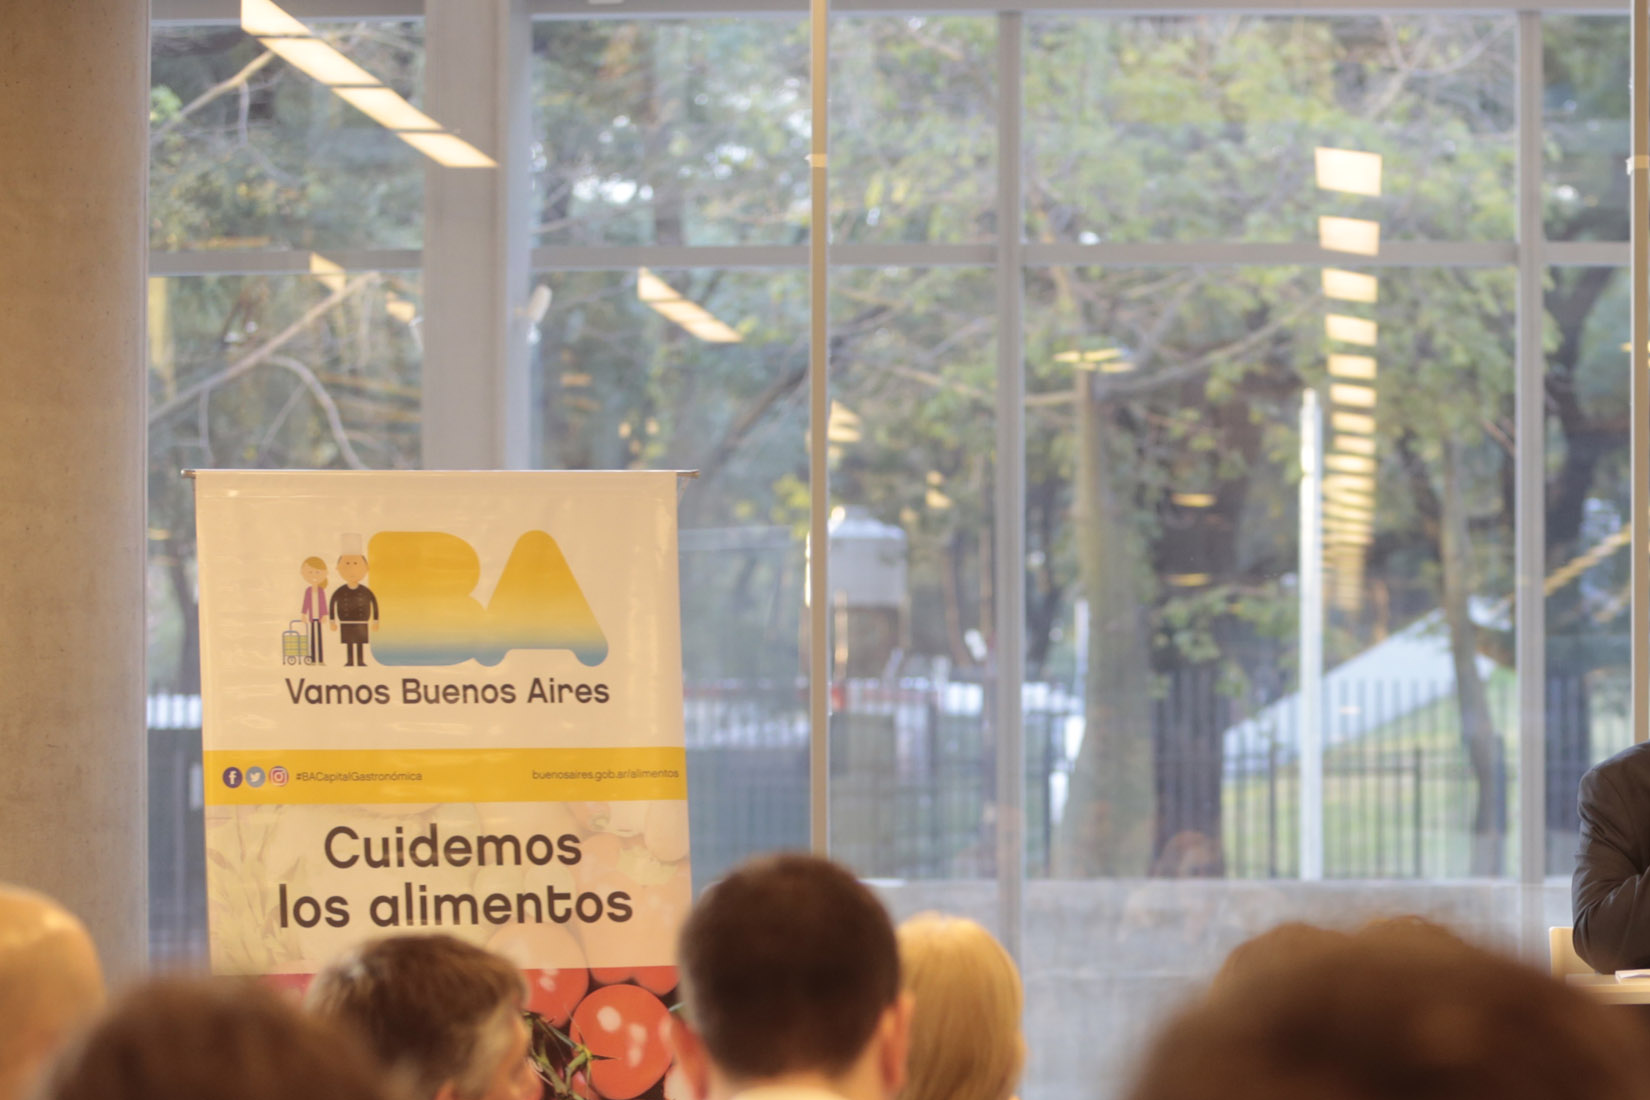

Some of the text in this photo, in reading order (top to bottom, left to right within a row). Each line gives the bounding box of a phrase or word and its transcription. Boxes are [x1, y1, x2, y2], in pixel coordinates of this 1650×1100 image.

[367, 529, 610, 667] BA
[284, 676, 611, 705] Vamos Buenos Aires
[296, 770, 423, 784] #BACapitalGastronómica
[532, 768, 680, 782] buenosaires.gob.ar/alimentos
[324, 822, 583, 869] Cuidemos
[278, 881, 634, 929] los alimentos
